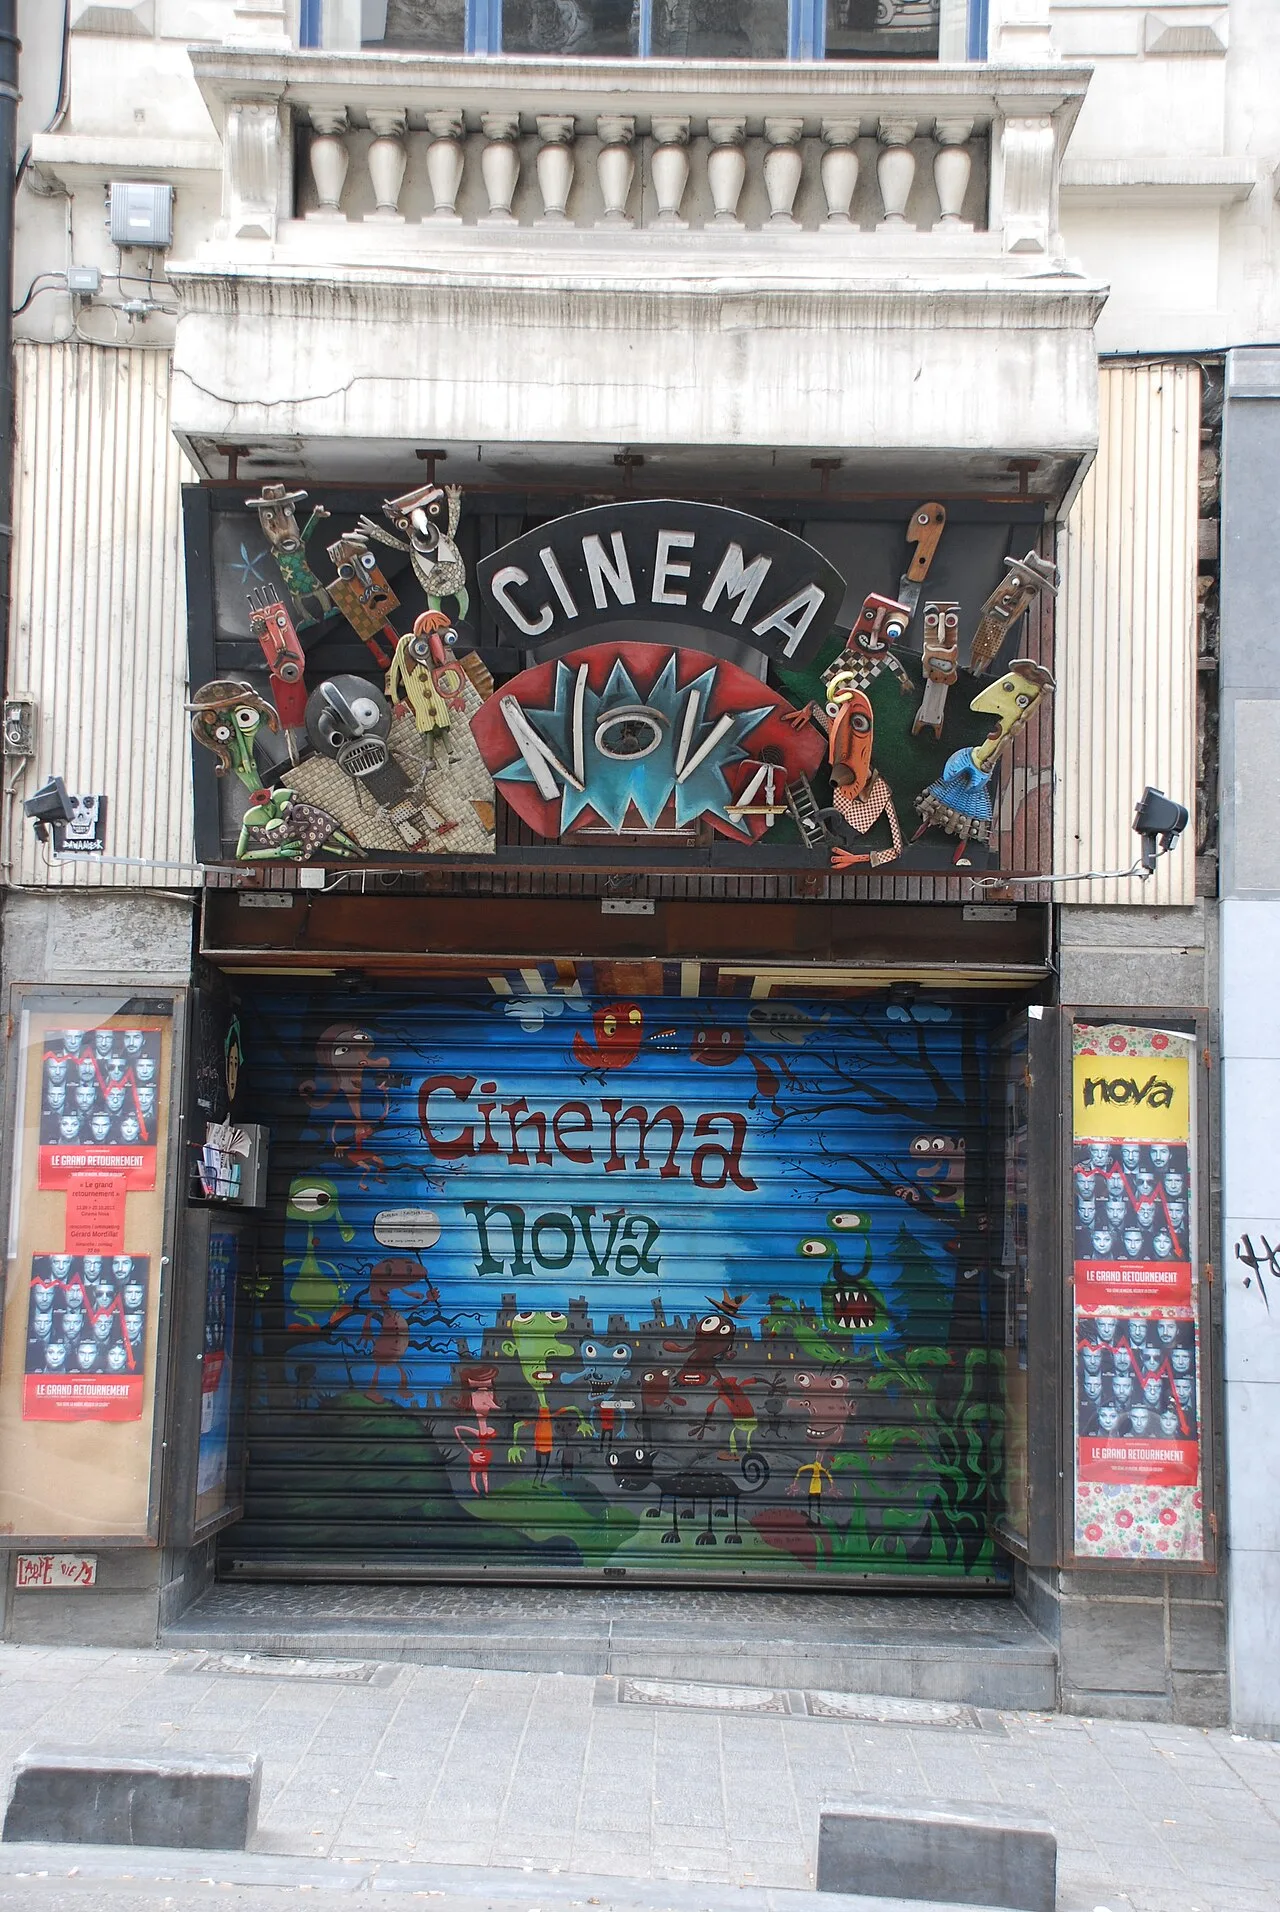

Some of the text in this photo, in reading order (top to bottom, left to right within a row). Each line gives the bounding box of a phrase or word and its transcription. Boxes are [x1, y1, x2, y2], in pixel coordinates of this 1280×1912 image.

[491, 529, 825, 659] CINEMA
[499, 662, 787, 828] NOVA
[1083, 1074, 1174, 1109] nova
[417, 1075, 759, 1192] Cinema
[52, 1155, 144, 1167] LE GRAND RETOURNEMENT
[463, 1200, 663, 1278] nova
[1086, 1270, 1178, 1283] LE GRAND RETOURNEMENT
[37, 1384, 130, 1396] LE GRAND RETOURNEMENT
[1092, 1447, 1184, 1462] LE GRAND RETOURNEMENT
